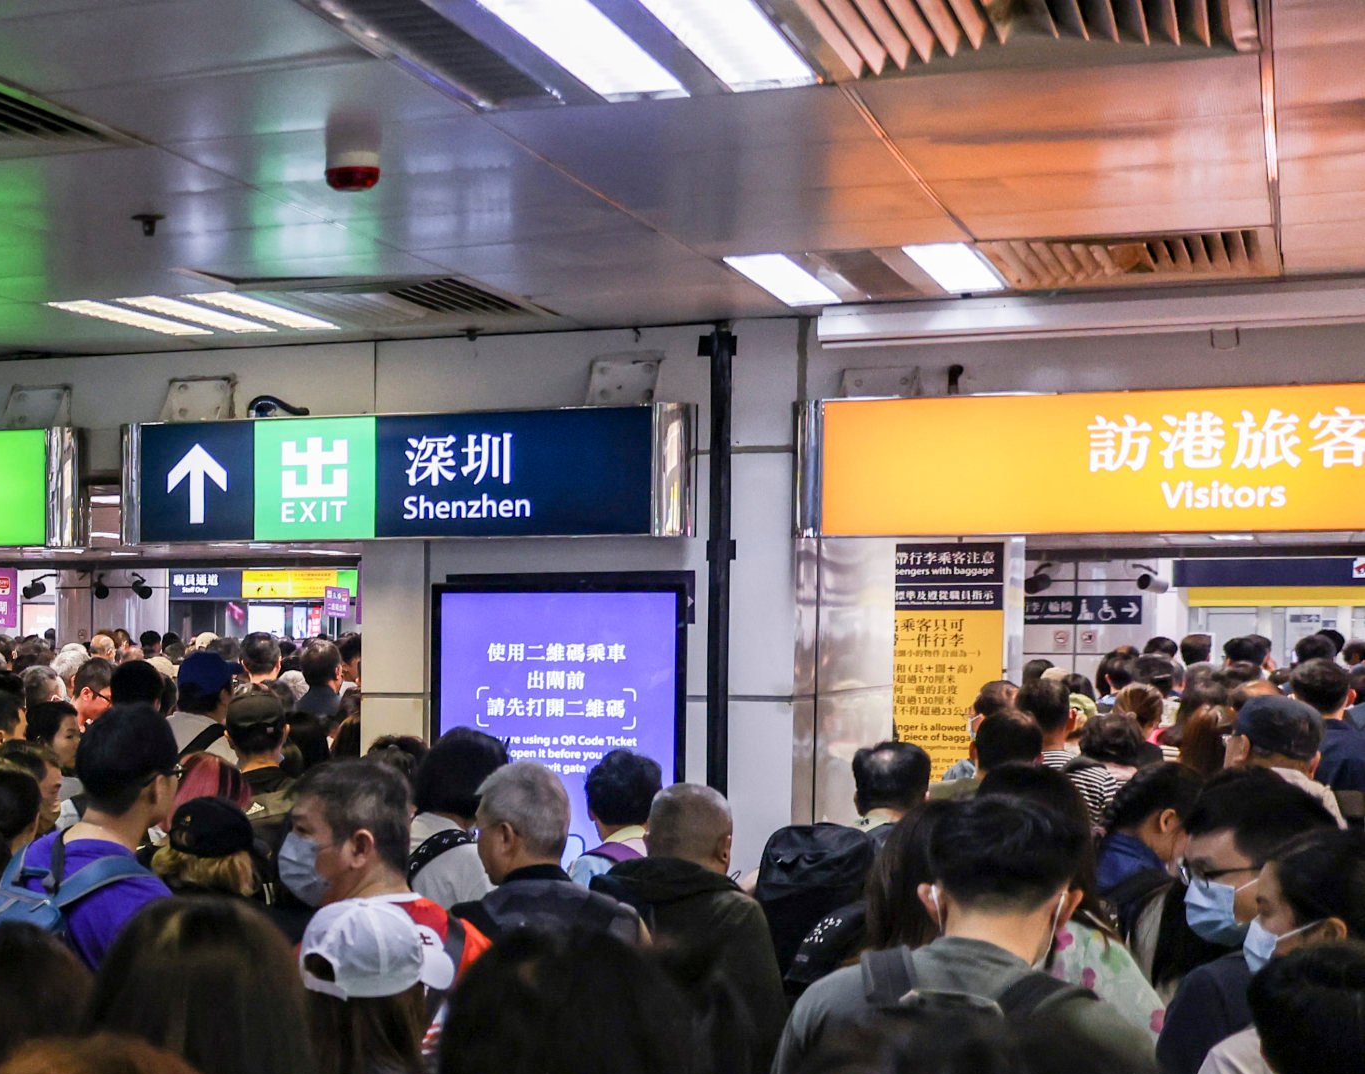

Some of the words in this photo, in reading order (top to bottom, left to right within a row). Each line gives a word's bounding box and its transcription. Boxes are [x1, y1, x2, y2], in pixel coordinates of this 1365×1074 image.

[1086, 406, 1365, 472] 訪港旅客
[281, 437, 348, 498] 出
[405, 433, 513, 486] 深圳
[1160, 480, 1287, 509] Visitors
[281, 501, 348, 523] EXIT
[403, 494, 531, 519] Shenzhen
[173, 574, 218, 586] 職員通道
[931, 567, 951, 575] with
[954, 566, 994, 577] baggage
[195, 586, 209, 595] Only
[487, 642, 626, 663] 使用二維碼乘車
[527, 670, 585, 690] 出閘前
[487, 697, 625, 718] 請先打開二維碼
[904, 733, 925, 742] piece
[930, 733, 940, 741] of
[920, 723, 928, 731] is
[930, 723, 966, 732] allowed
[523, 734, 550, 747] using
[560, 735, 576, 745] QR
[577, 735, 604, 745] Code
[606, 735, 637, 746] Ticket
[510, 750, 536, 760] open
[538, 748, 546, 758] it
[548, 748, 581, 758] before
[583, 751, 602, 760] you
[563, 764, 586, 774] gate
